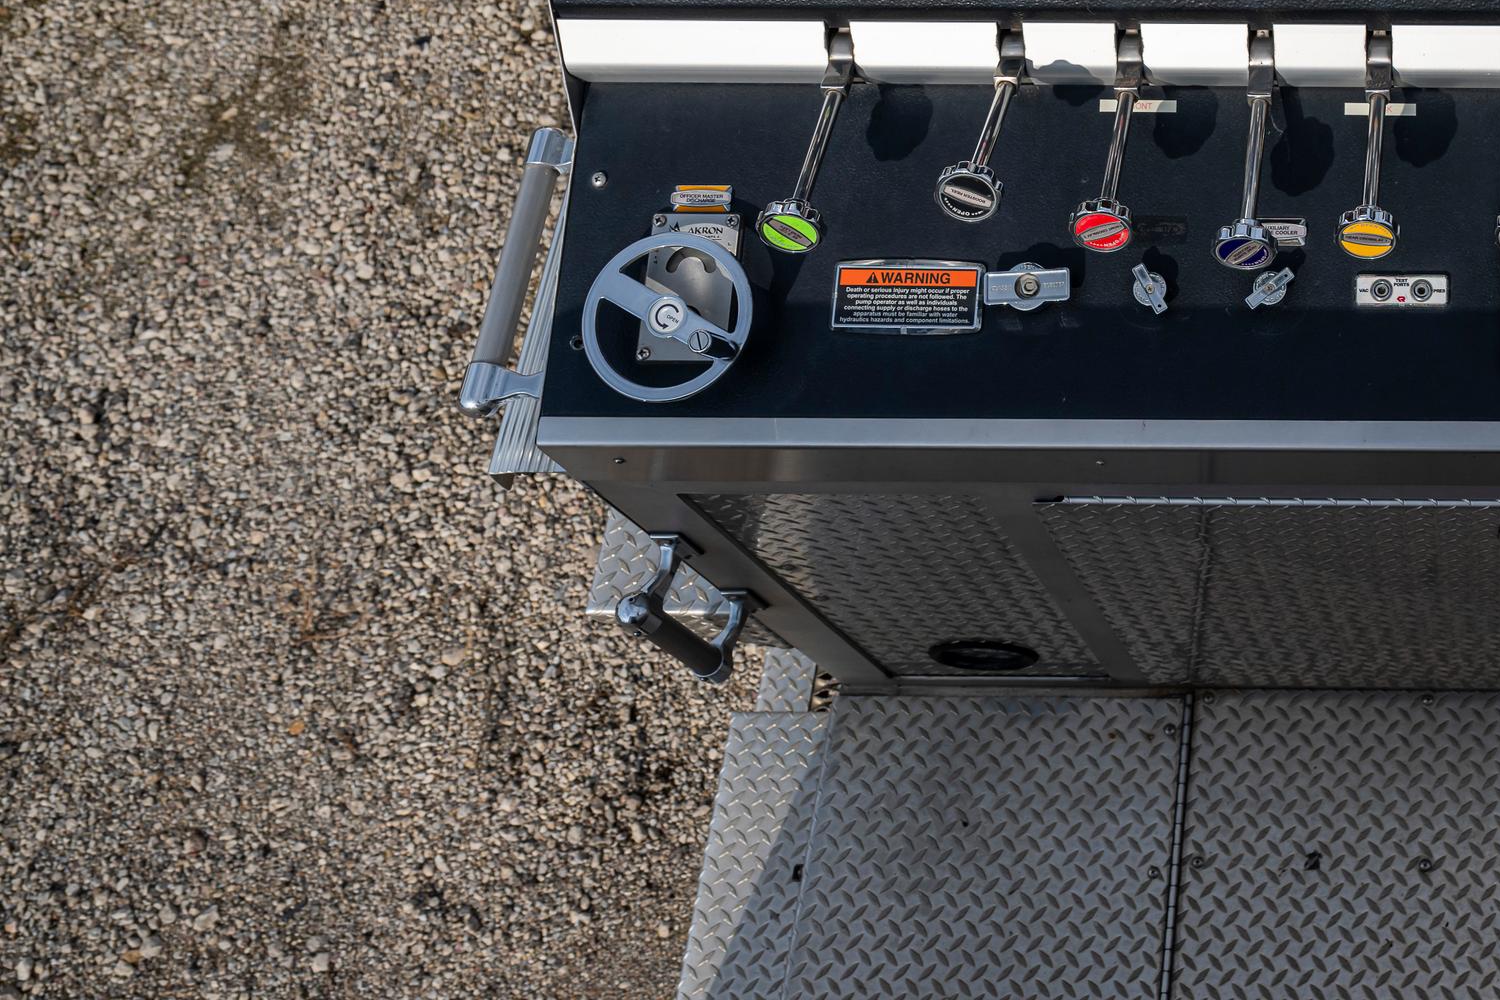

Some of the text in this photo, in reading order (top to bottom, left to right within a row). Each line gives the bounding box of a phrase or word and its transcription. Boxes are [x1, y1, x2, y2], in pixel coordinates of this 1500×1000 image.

[952, 206, 971, 216] OPEN
[881, 272, 951, 284] WARNING
[666, 314, 680, 324] OPEN
